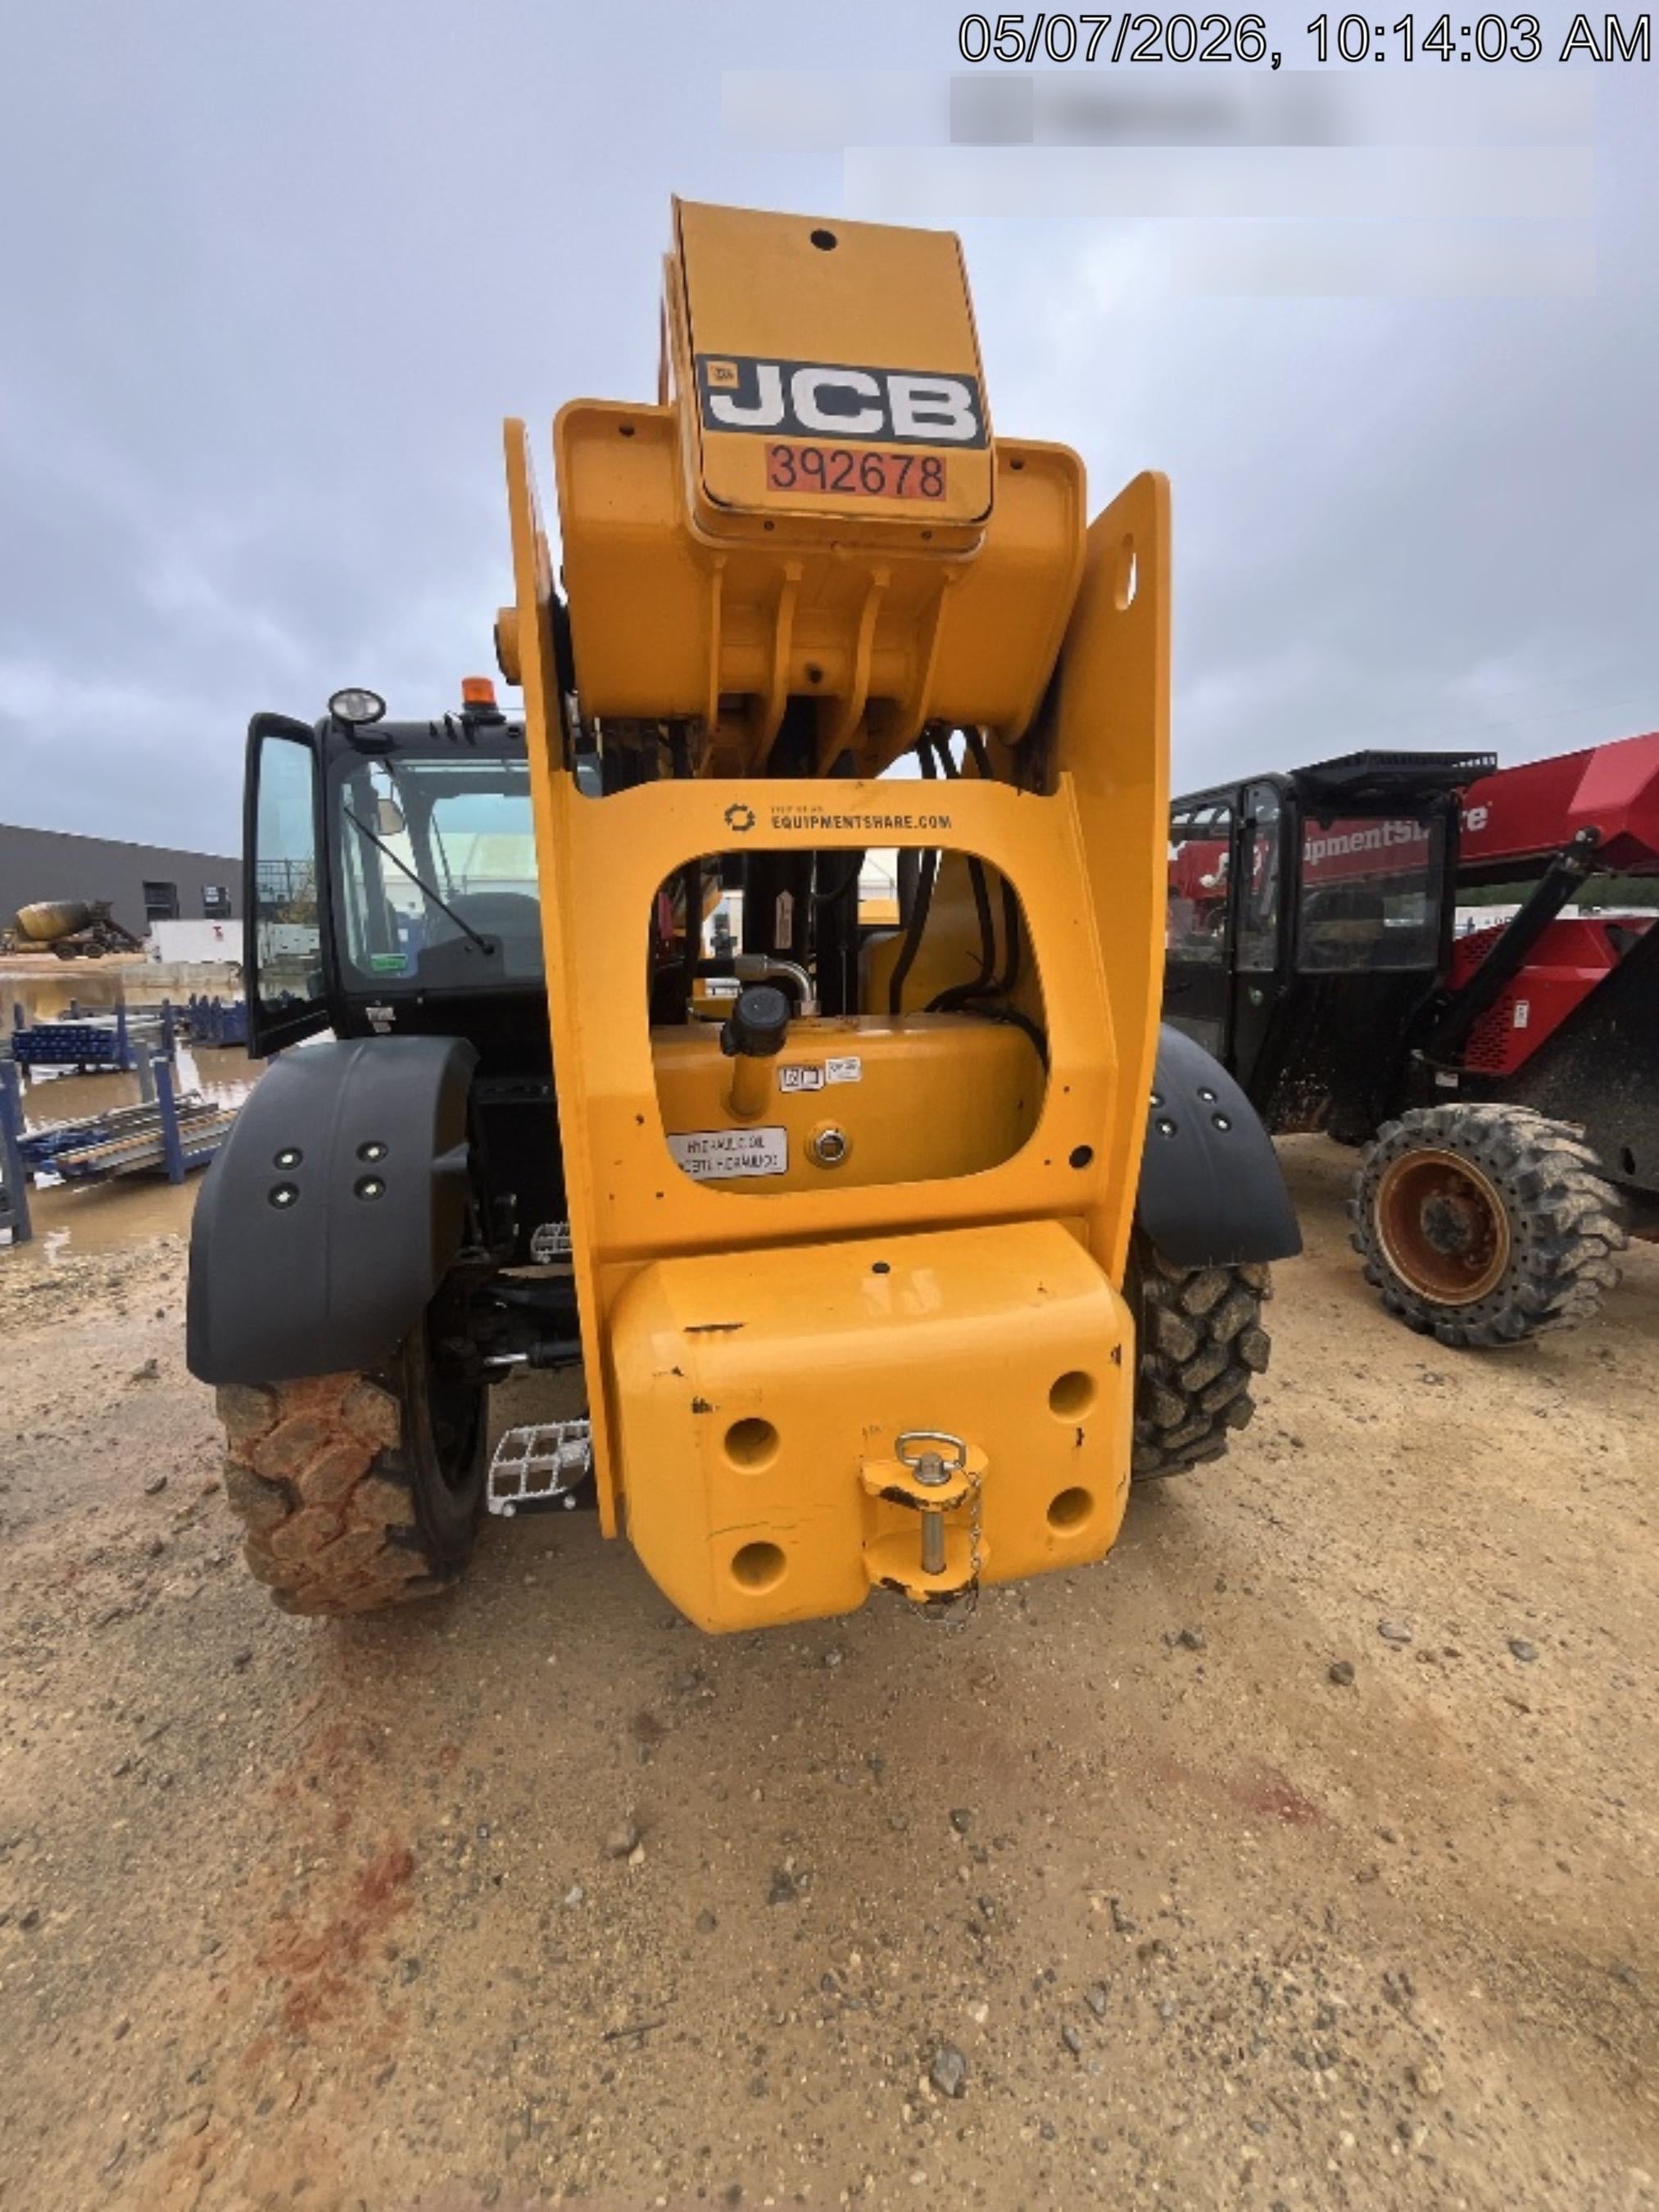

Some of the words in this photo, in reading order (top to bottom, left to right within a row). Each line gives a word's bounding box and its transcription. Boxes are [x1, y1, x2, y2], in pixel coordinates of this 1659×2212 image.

[709, 365, 977, 440] JCB
[772, 445, 944, 497] 392678
[772, 815, 952, 829] EQUIPMENTSHARE.COM
